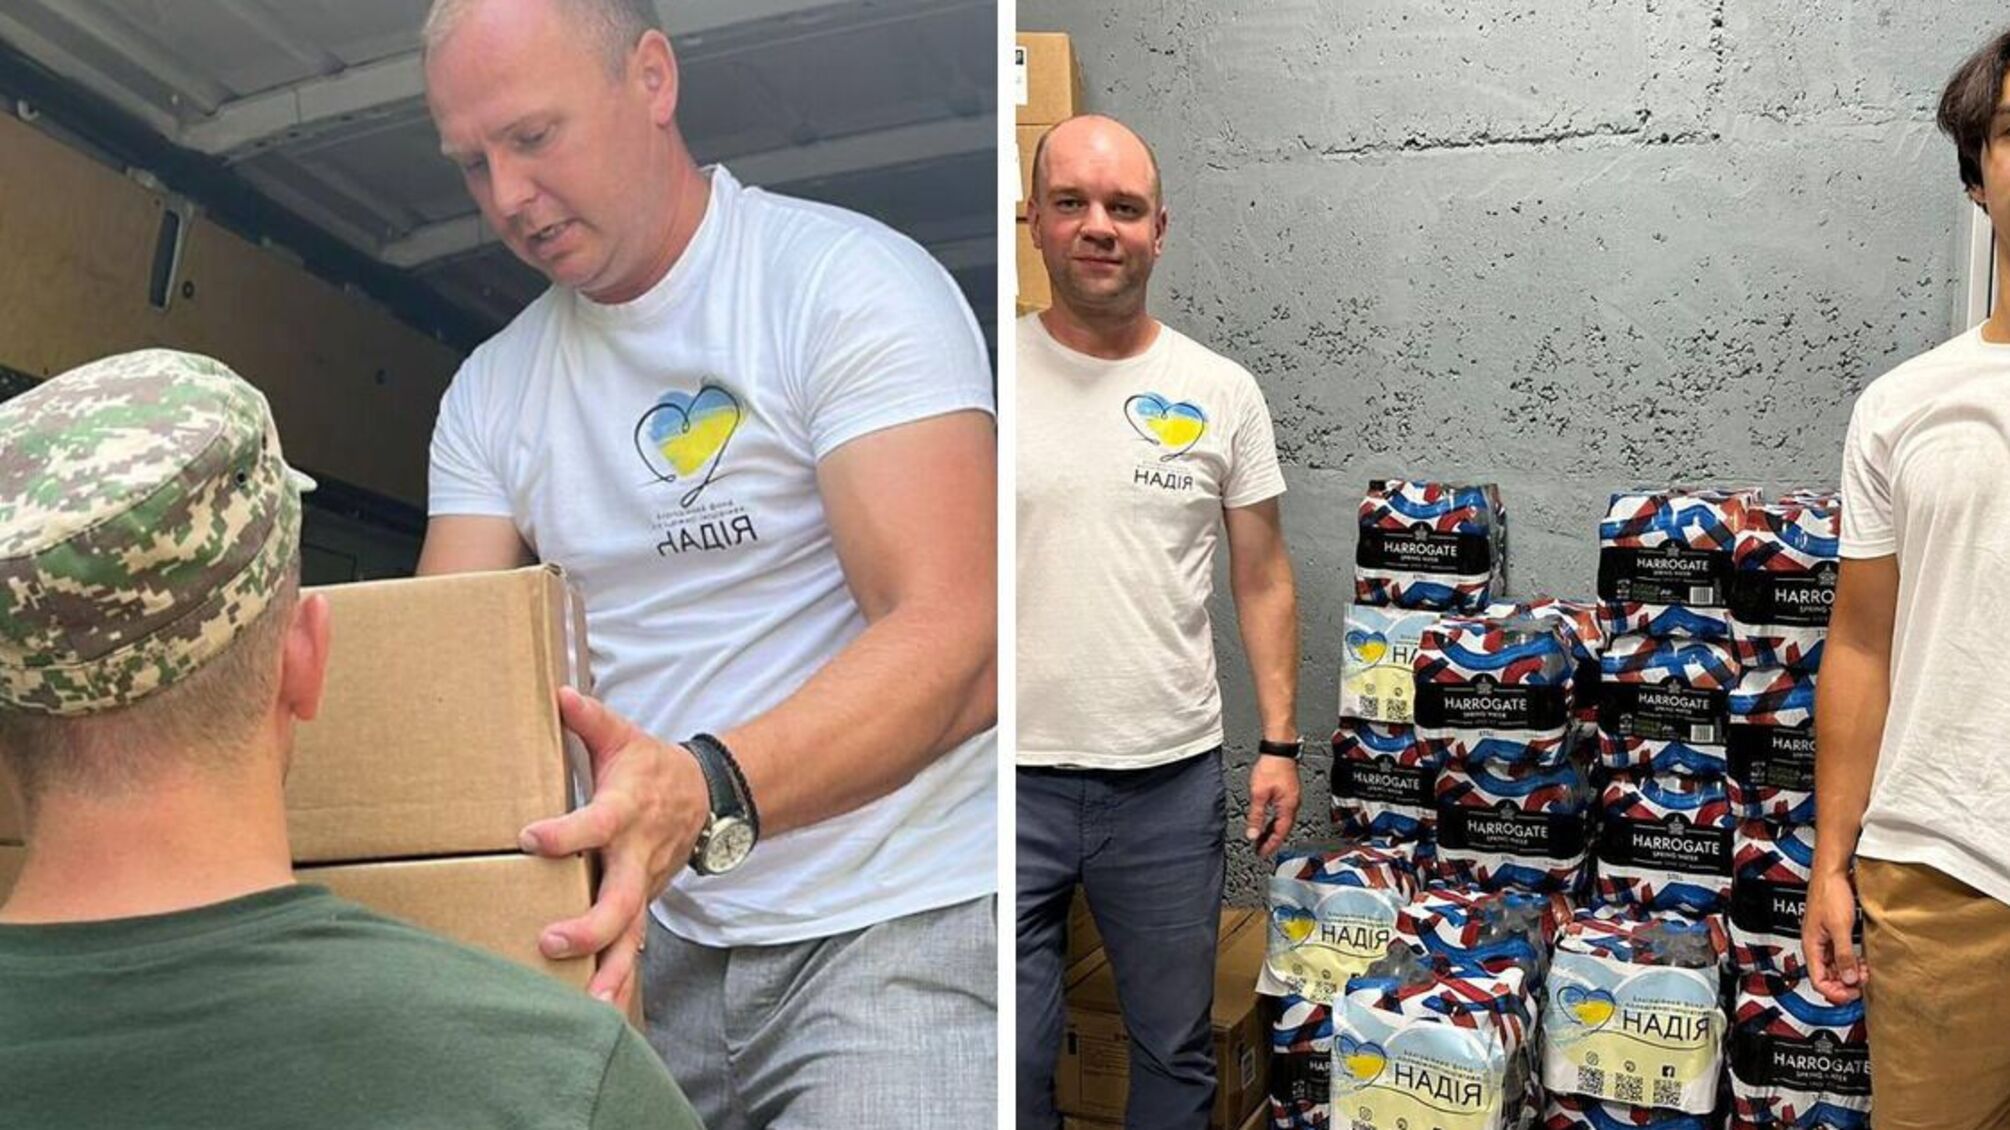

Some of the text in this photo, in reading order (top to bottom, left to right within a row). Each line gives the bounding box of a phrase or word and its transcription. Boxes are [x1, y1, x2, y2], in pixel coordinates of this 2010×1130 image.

[1134, 469, 1193, 491] НАДІЯ
[657, 514, 758, 556] НАДІЯ
[1384, 541, 1458, 557] HARROGATE
[1636, 558, 1709, 572] HARROGATE
[1775, 588, 1836, 604] HARRO
[1444, 697, 1527, 711] HARROGATE
[1639, 692, 1710, 710] HARROGATE
[1772, 737, 1816, 751] HARRO
[1353, 771, 1420, 791] HARROGATE
[1467, 820, 1549, 839] HARROGATE
[1633, 833, 1720, 855] HARROGATE
[1321, 924, 1389, 950] НАДІЯ
[1623, 1009, 1710, 1041] НАДІЯ
[1773, 1052, 1873, 1075] HARROGATE
[1395, 1063, 1482, 1106] НАДІЯ
